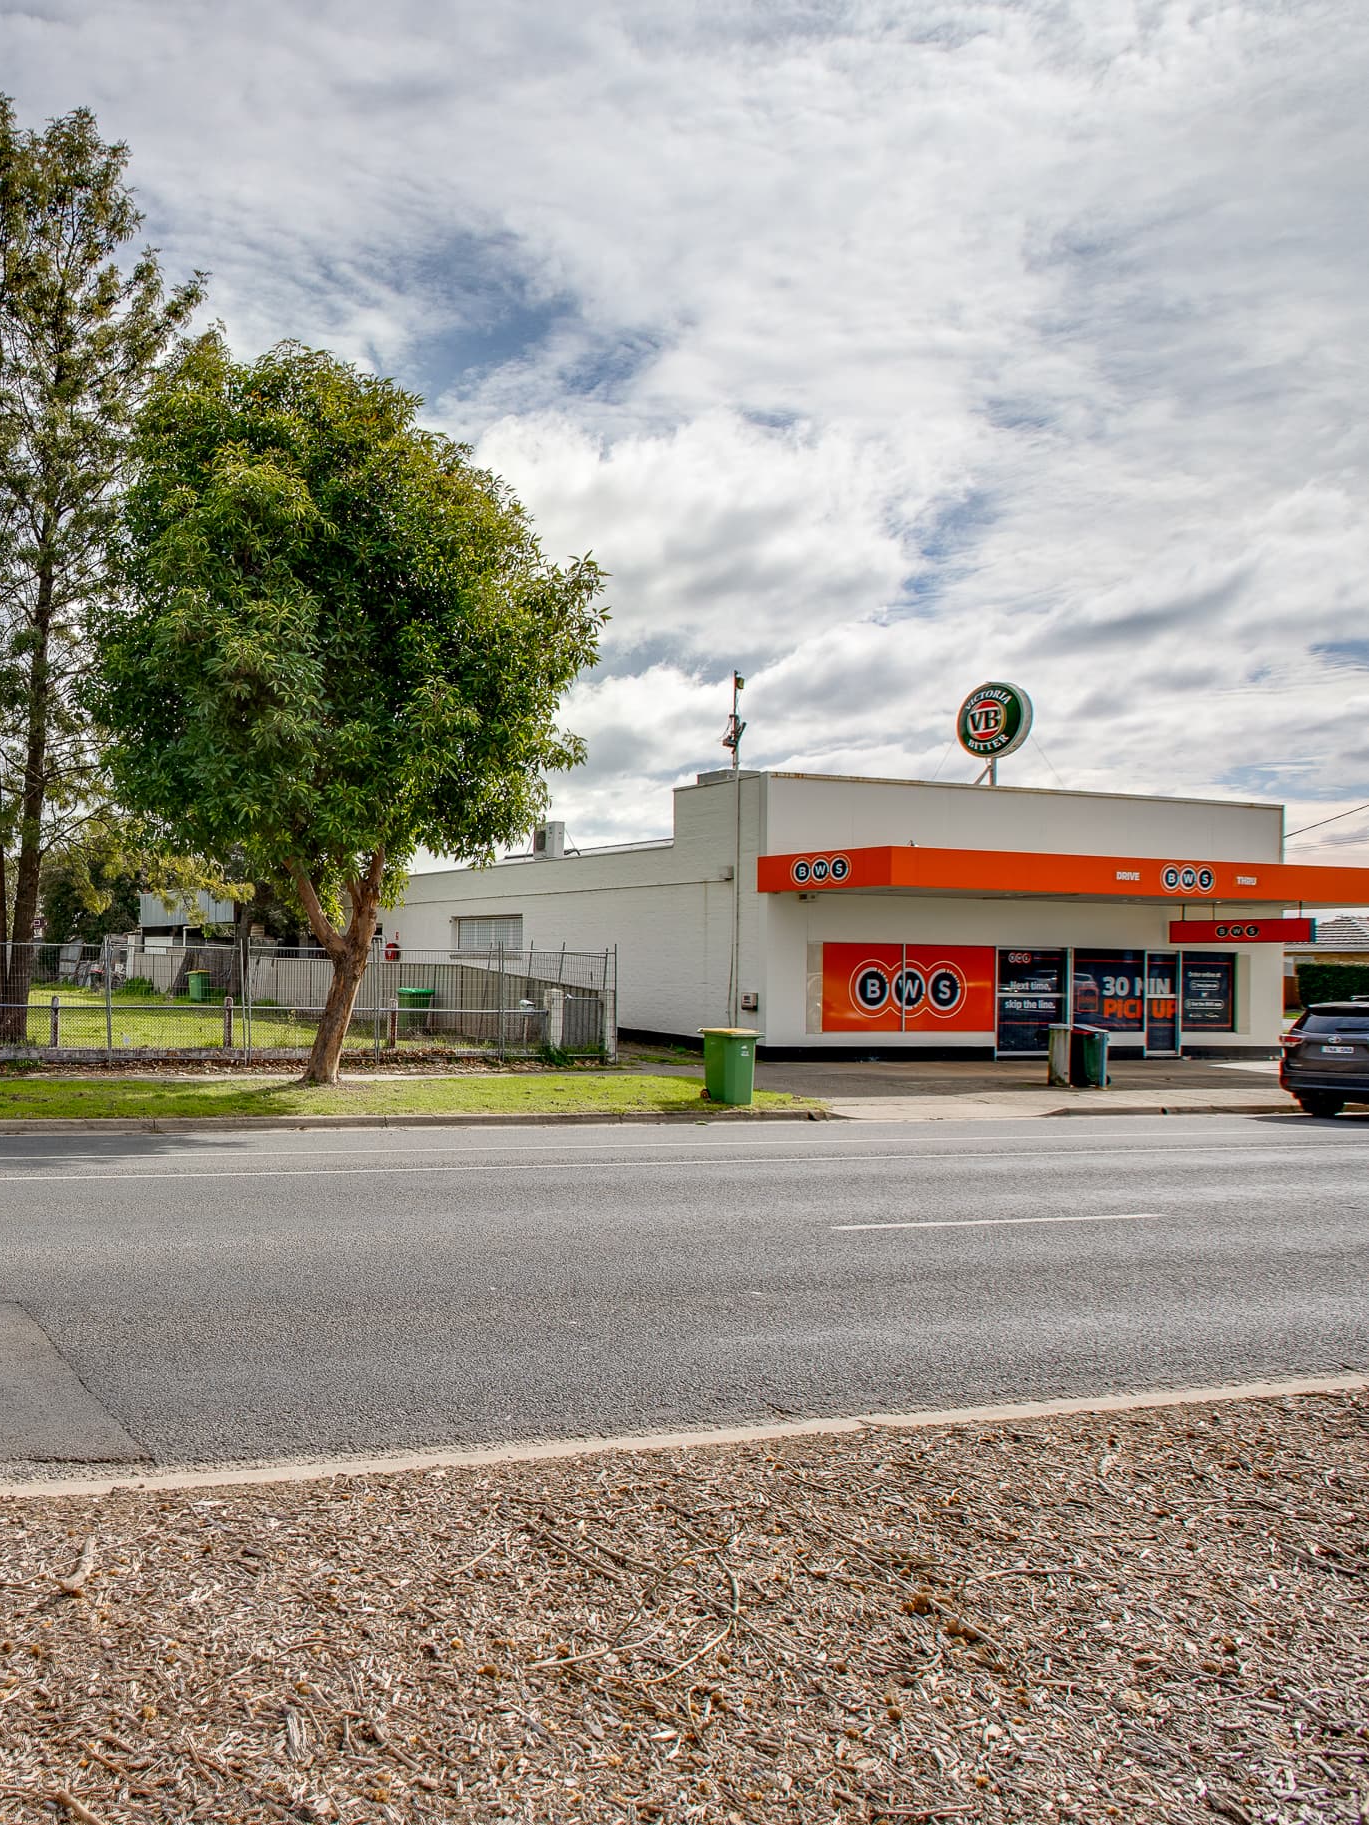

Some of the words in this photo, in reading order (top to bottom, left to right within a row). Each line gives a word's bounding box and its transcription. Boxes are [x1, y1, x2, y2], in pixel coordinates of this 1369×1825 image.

[965, 689, 1013, 710] VICTORIA
[969, 709, 1000, 731] VB
[967, 733, 1010, 751] BITTER
[1116, 871, 1141, 881] DRIVE
[1009, 980, 1029, 991] Next
[1102, 976, 1130, 997] 30
[1004, 999, 1022, 1010] skip
[1023, 999, 1037, 1009] the
[1038, 999, 1056, 1009] line.
